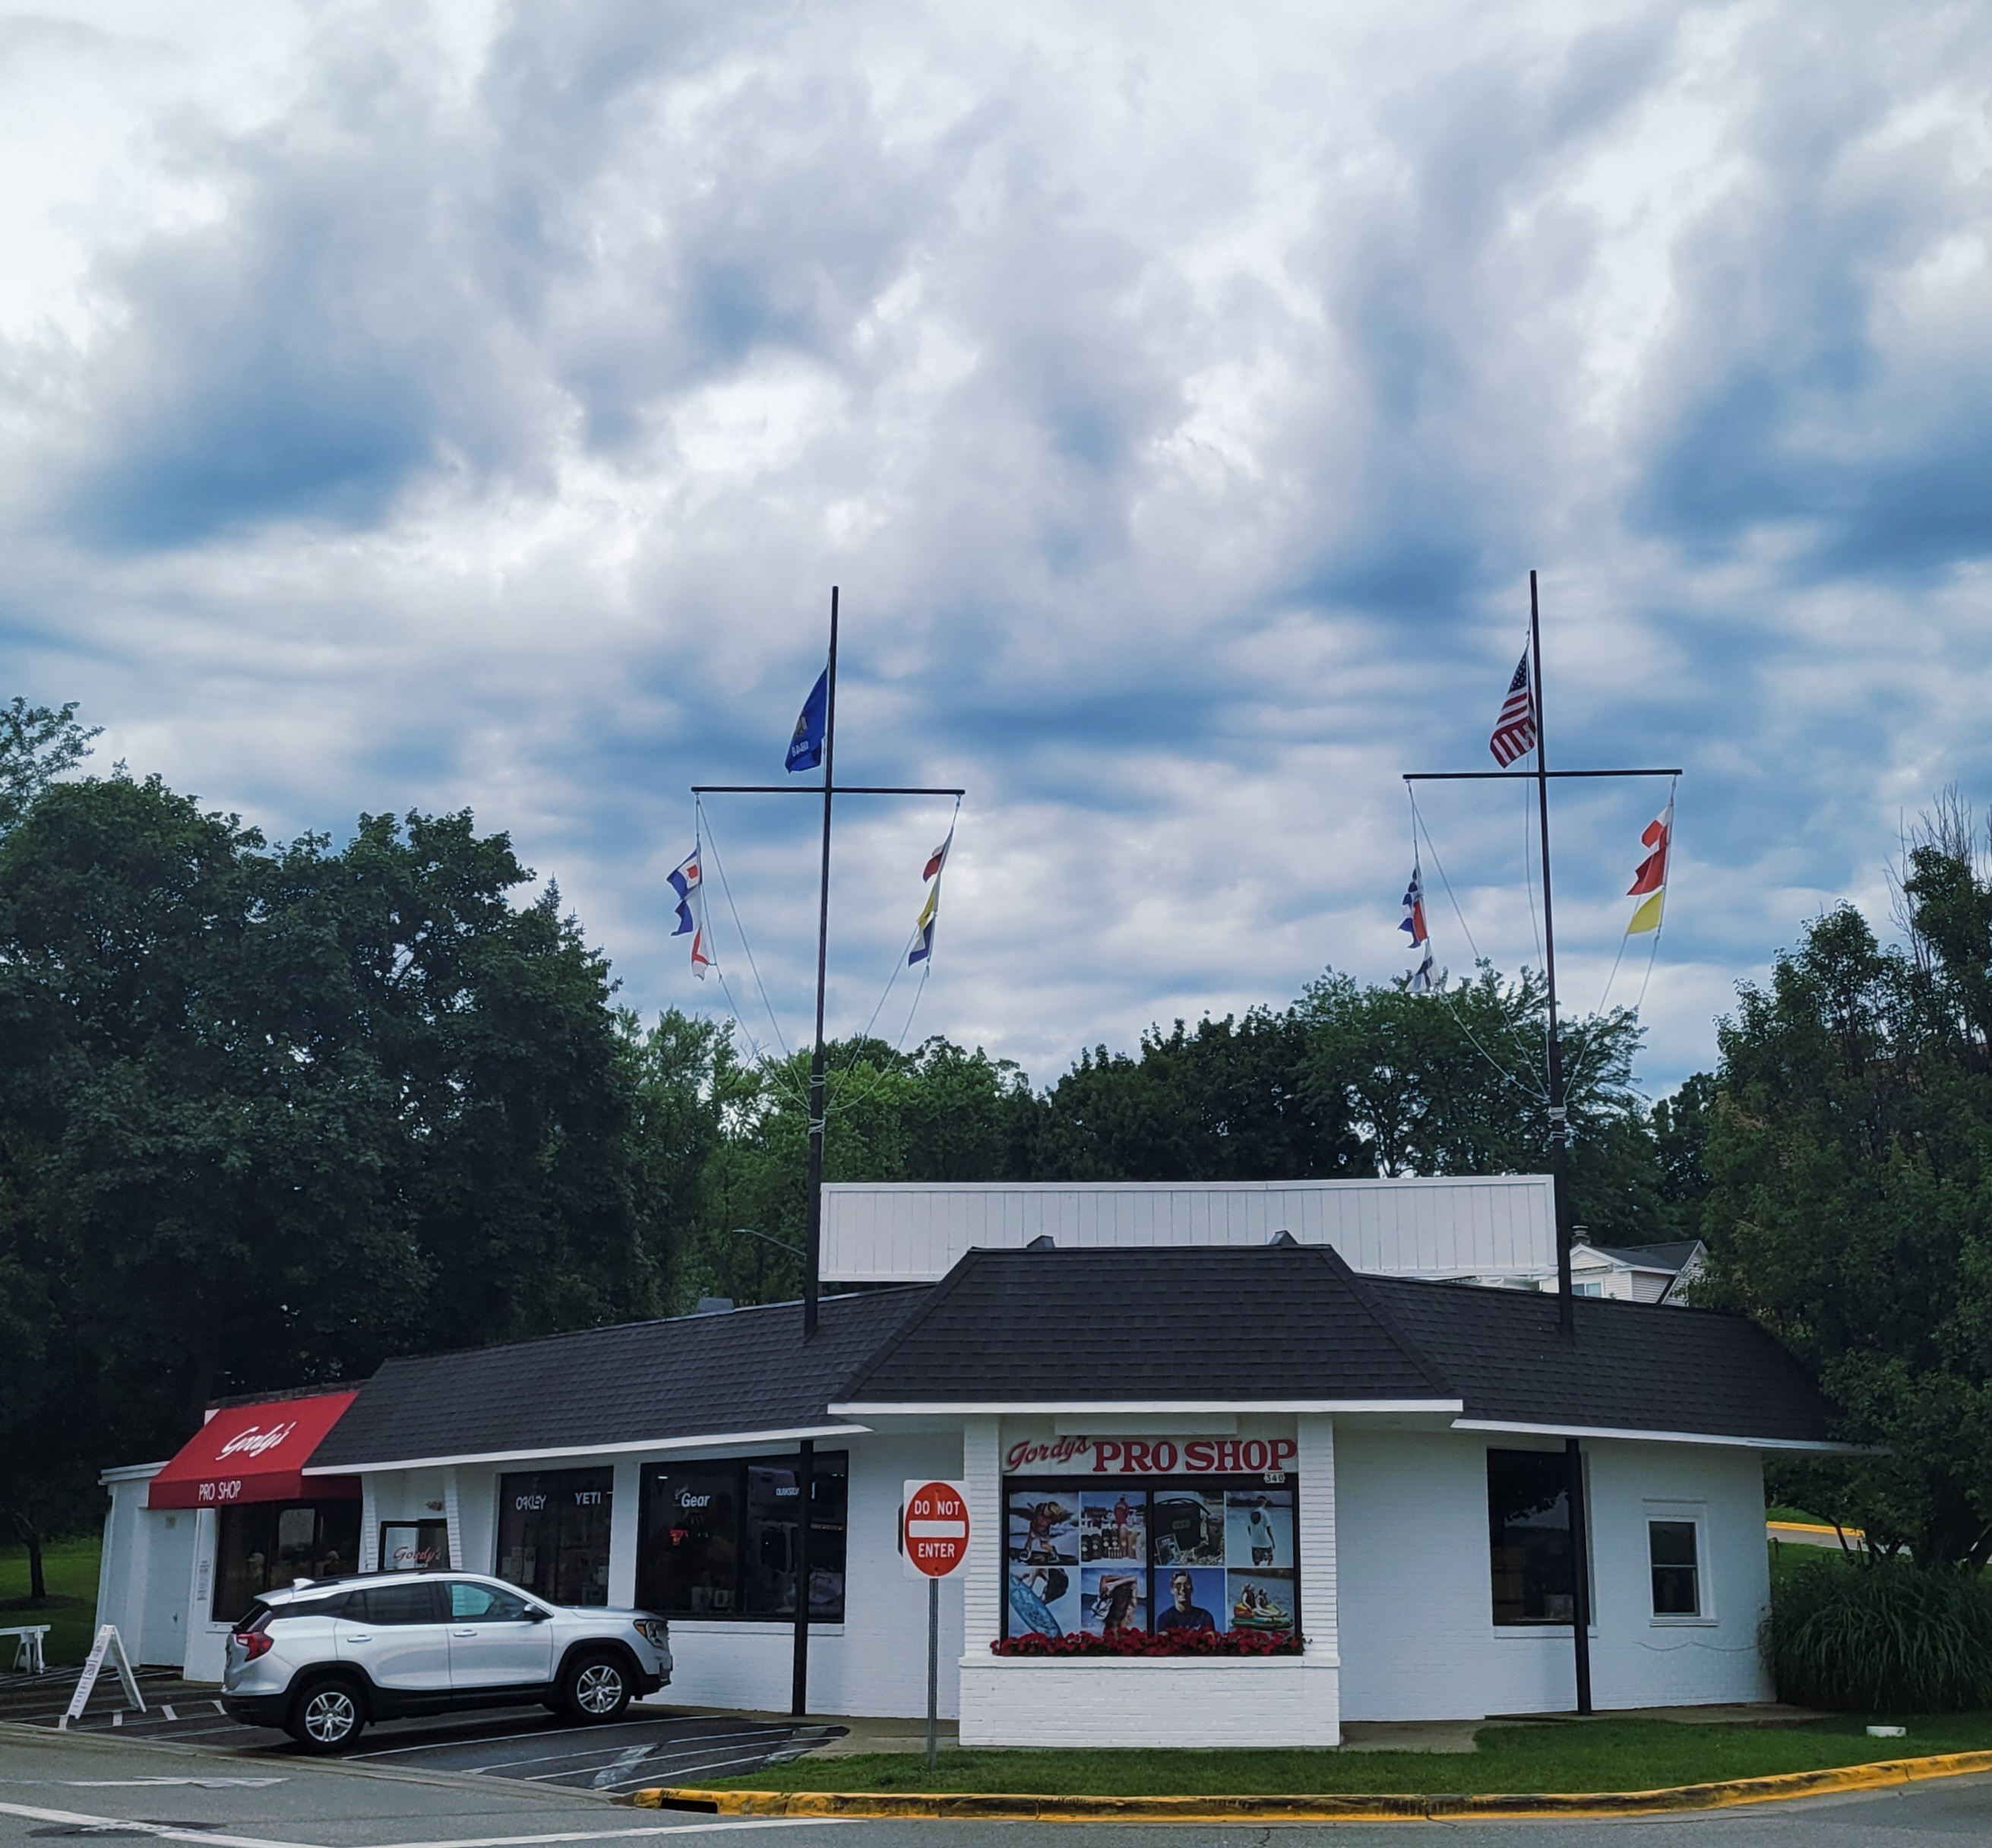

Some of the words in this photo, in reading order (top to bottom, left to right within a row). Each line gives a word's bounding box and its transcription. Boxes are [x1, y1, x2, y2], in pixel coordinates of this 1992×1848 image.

[1002, 1435, 1091, 1473] Gordy's
[1092, 1441, 1178, 1473] PRO
[1184, 1438, 1298, 1472] SHOP
[1265, 1473, 1284, 1483] 340
[198, 1483, 215, 1502] PRO
[217, 1480, 242, 1501] SHOP
[574, 1492, 601, 1505] YETI
[515, 1494, 547, 1511] OAKLEY
[681, 1492, 711, 1508] Gear
[914, 1500, 930, 1515] DO
[937, 1501, 960, 1516] NOT
[918, 1543, 956, 1558] ENTER
